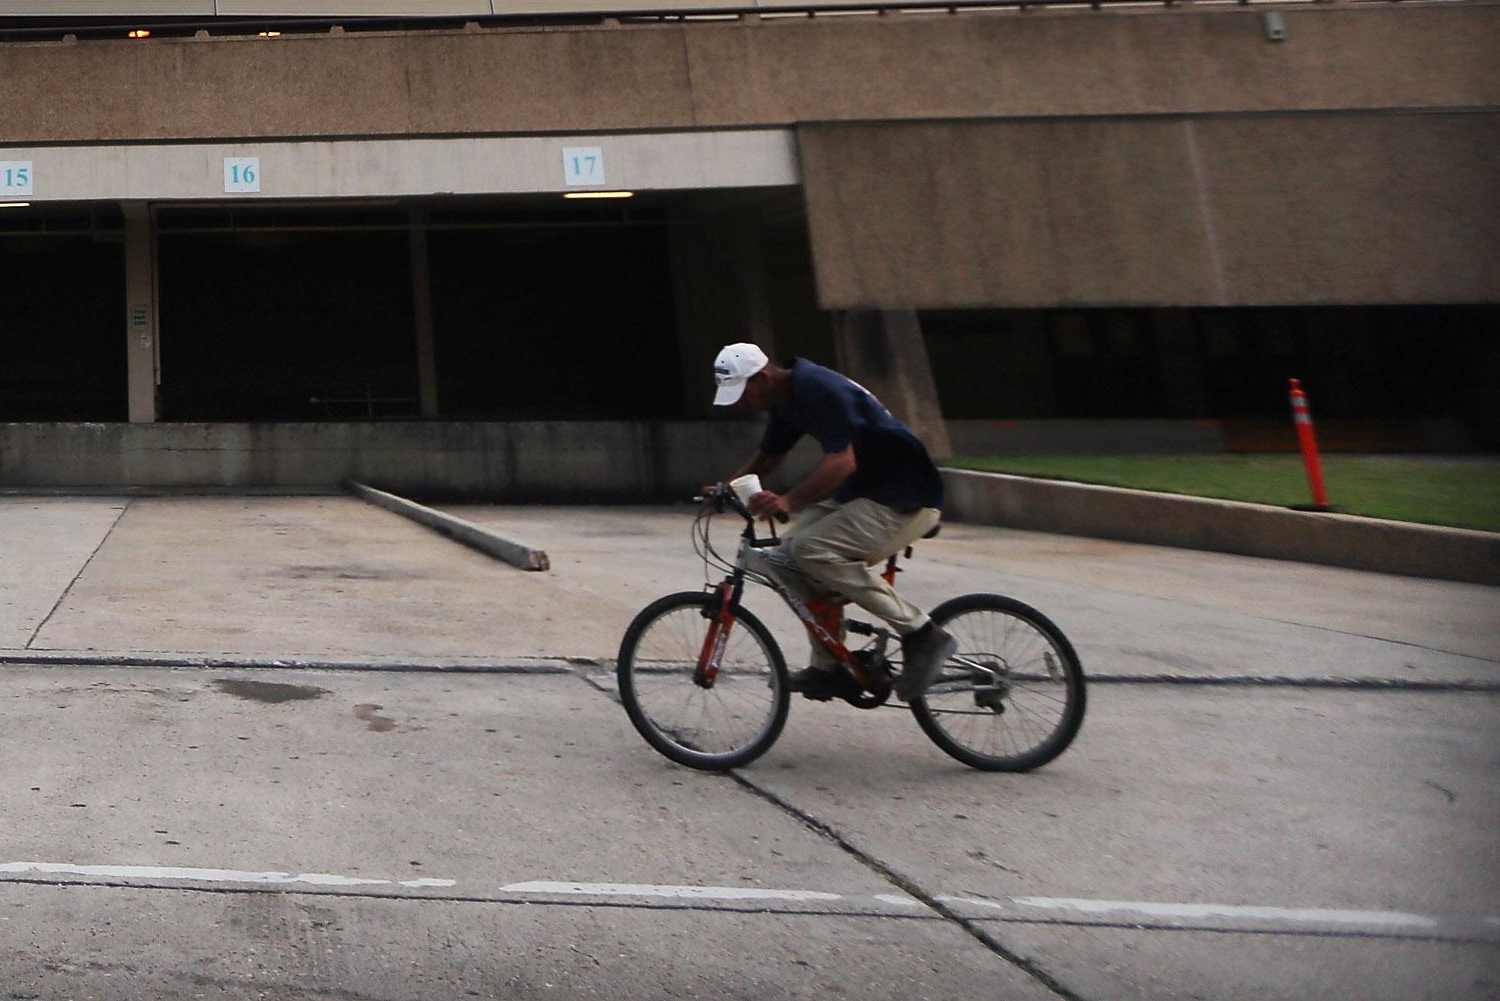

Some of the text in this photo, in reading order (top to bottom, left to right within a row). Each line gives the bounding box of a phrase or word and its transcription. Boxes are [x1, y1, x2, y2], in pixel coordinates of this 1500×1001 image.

[230, 164, 255, 184] 16
[573, 155, 596, 175] 17
[5, 168, 28, 187] 15
